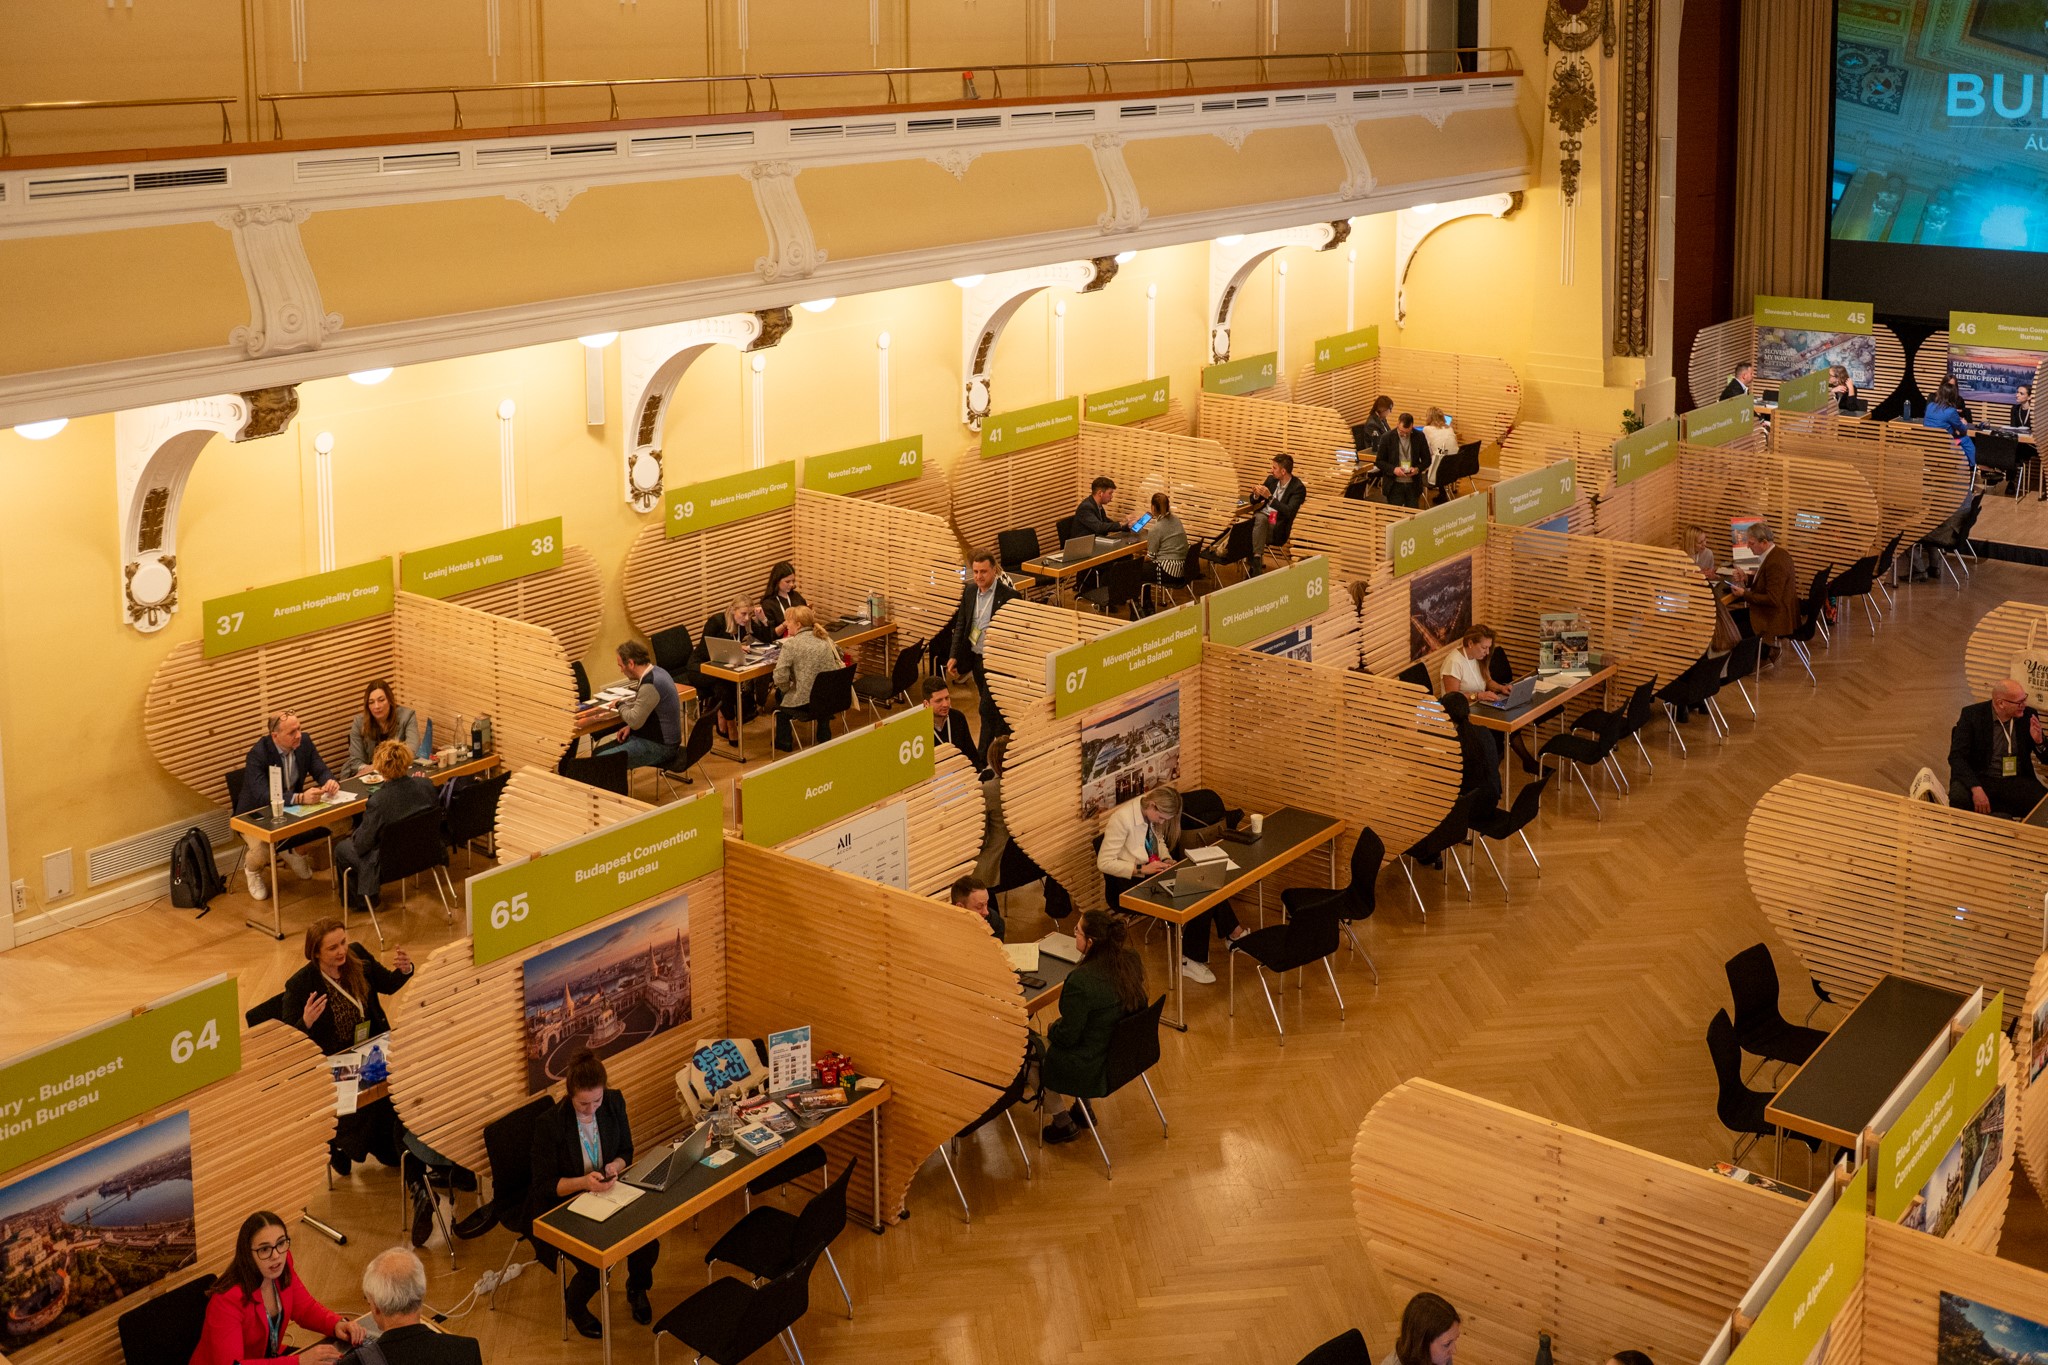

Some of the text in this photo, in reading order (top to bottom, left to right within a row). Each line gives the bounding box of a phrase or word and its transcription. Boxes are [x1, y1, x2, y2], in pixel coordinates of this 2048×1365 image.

[1947, 73, 2048, 118] BU
[1847, 312, 1866, 324] 45
[1957, 322, 1976, 335] 46
[1319, 349, 1330, 361] 44
[1262, 364, 1273, 376] 43
[1153, 389, 1165, 403] 42
[1819, 380, 1826, 394] 73
[1741, 408, 1750, 423] 72
[989, 428, 1001, 442] 41
[899, 450, 916, 466] 40
[1623, 453, 1630, 470] 71
[828, 464, 872, 479] Novotel Zagreb
[711, 482, 788, 507] Maistra Hospitality Group
[1560, 477, 1571, 494] 70
[674, 501, 694, 520] 39
[531, 536, 554, 556] 38
[1400, 538, 1415, 558] 69
[423, 566, 447, 580] Losinj
[449, 561, 474, 574] Hotels
[482, 554, 503, 565] Villas
[1306, 577, 1322, 598] 68
[274, 585, 379, 617] Arena Hospitality Group
[1222, 595, 1289, 626] CPI Hotels Hungary Kft
[216, 612, 244, 636] 37
[1102, 625, 1197, 668] Mövenpick BalaLand Resort
[1129, 648, 1172, 671] Lake Balaton
[1065, 667, 1088, 694] 67
[899, 735, 924, 765] 66
[805, 781, 833, 800] Accor
[838, 833, 851, 849] All
[575, 828, 698, 883] Budapest Convention
[618, 861, 658, 884] Bureau
[490, 892, 529, 930] 65
[170, 1018, 221, 1064] 64
[1975, 1032, 1994, 1077] 93
[39, 1056, 124, 1101] Budapest
[36, 1090, 99, 1125] Bureau
[1895, 1104, 1953, 1189] Convention Bureau
[1896, 1136, 1911, 1167] Bled
[1912, 1108, 1934, 1146] Tourist
[1793, 1302, 1805, 1329] Hit
